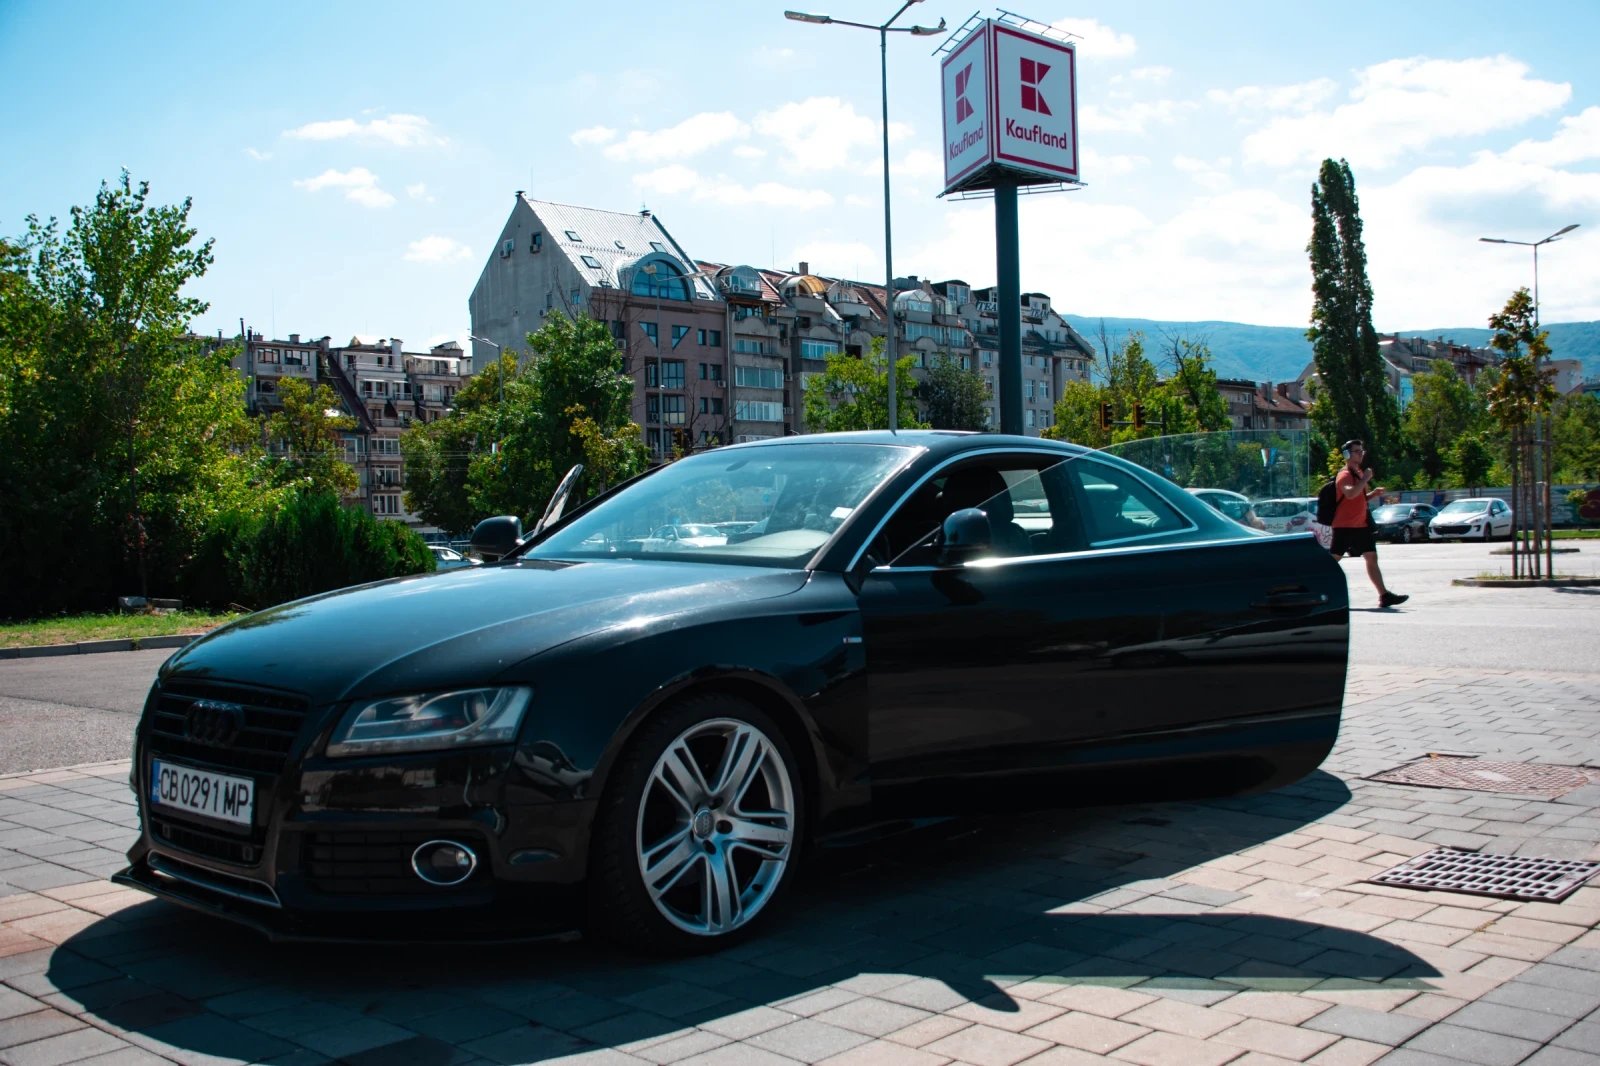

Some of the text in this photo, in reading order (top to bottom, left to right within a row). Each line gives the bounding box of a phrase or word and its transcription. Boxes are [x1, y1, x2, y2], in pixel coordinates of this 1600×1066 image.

[1020, 57, 1052, 116] K
[950, 120, 983, 160] Kaufland
[1006, 118, 1066, 149] Kaufland
[977, 301, 997, 311] TEA
[160, 769, 249, 817] CB 0291 MP
